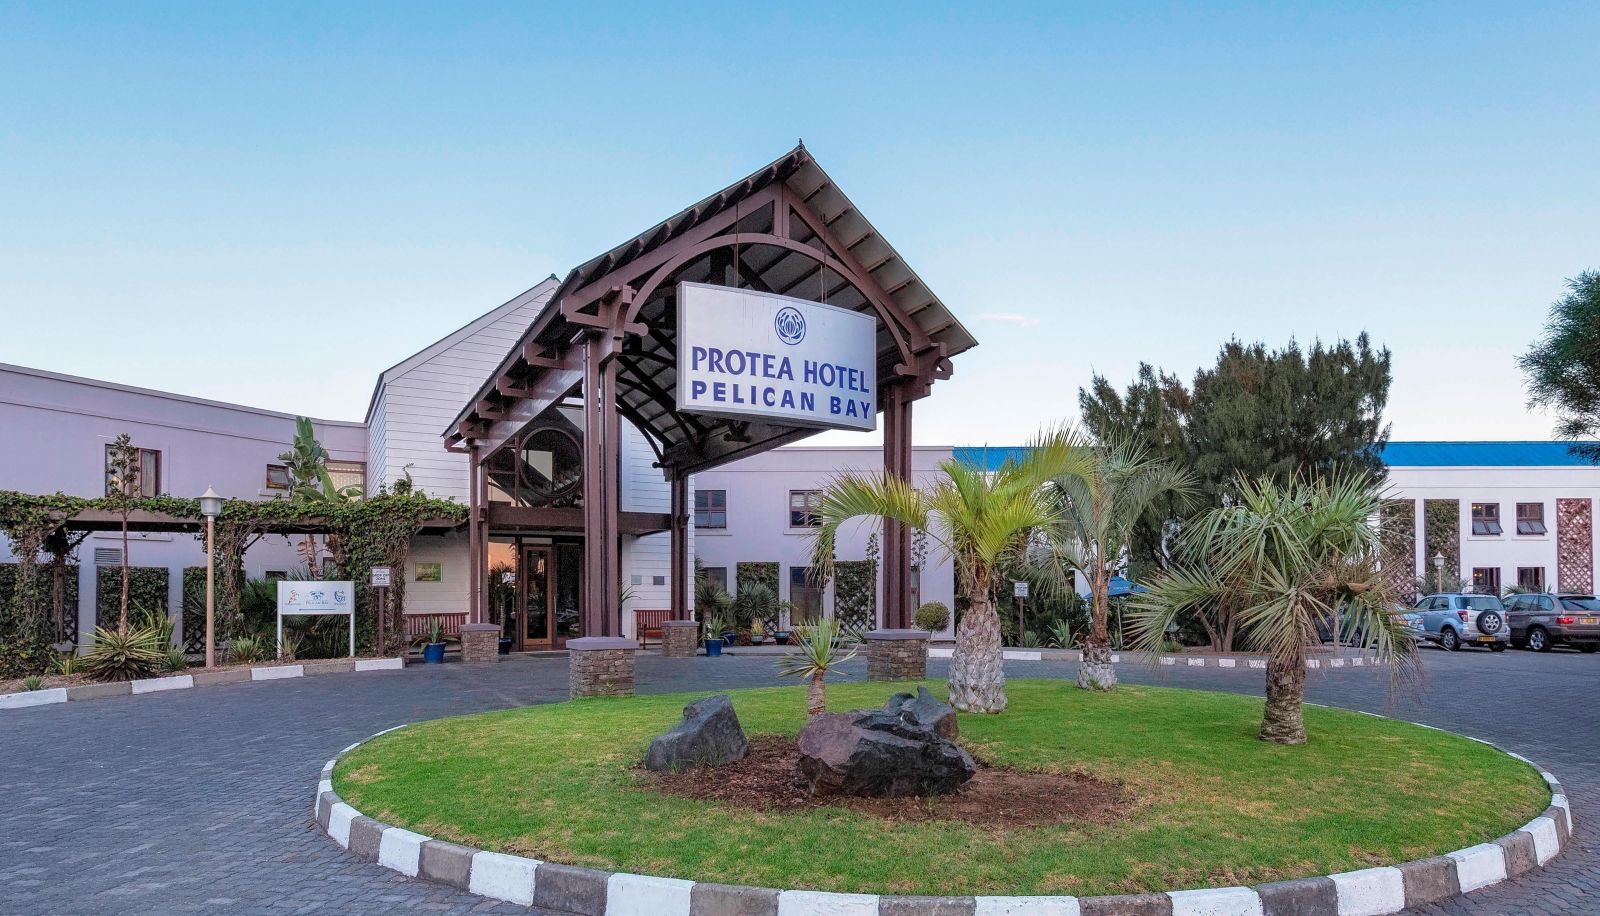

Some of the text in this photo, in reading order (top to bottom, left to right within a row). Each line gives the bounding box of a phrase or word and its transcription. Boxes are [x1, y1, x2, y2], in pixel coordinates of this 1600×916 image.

[691, 346, 870, 393] PROTEA HOTEL
[691, 381, 871, 419] PELICAN BAY
